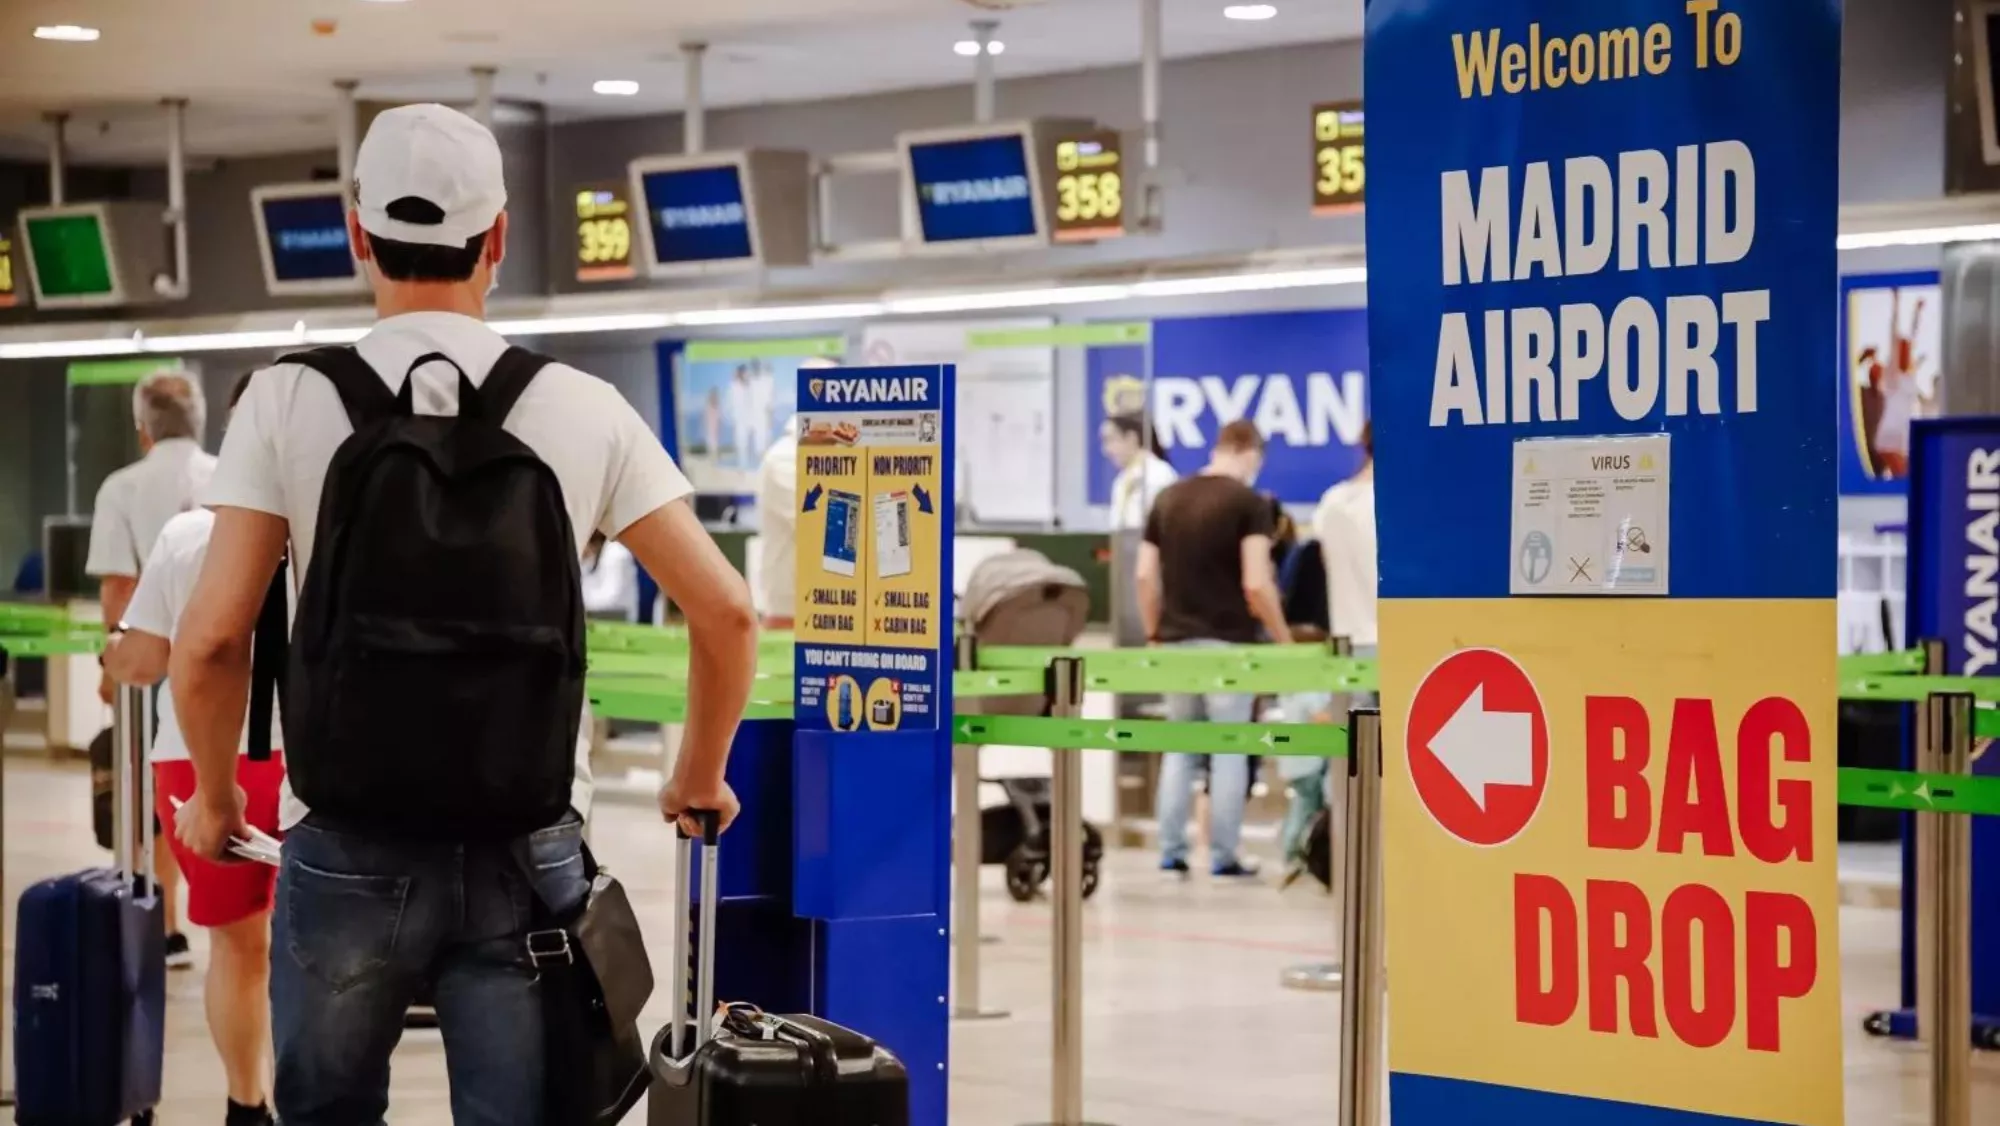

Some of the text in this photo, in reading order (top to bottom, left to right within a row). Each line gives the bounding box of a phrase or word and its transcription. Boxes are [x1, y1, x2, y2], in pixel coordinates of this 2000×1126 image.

[1452, 0, 1742, 99] Welcome To
[1316, 145, 1365, 195] 35
[1057, 172, 1121, 221] 358
[1441, 140, 1756, 286] MADRID
[578, 218, 629, 263] 359
[1429, 289, 1771, 427] AIRPORT
[825, 377, 928, 403] RYANAIR
[1154, 371, 1364, 448] RYAN
[806, 456, 857, 476] PRIORITY
[874, 455, 933, 476] NON PRIORITY
[1592, 455, 1630, 471] VIRUS
[1963, 447, 2000, 690] YANAIR
[812, 588, 857, 607] SMALL BAG
[884, 592, 929, 609] SMALL BAG
[812, 613, 854, 632] CABIN BAG
[884, 617, 927, 635] CABIN BAG
[804, 648, 928, 671] YOU CAN'T BRING ON BOARD
[1585, 696, 1813, 864] BAG
[1513, 873, 1818, 1053] DROP
